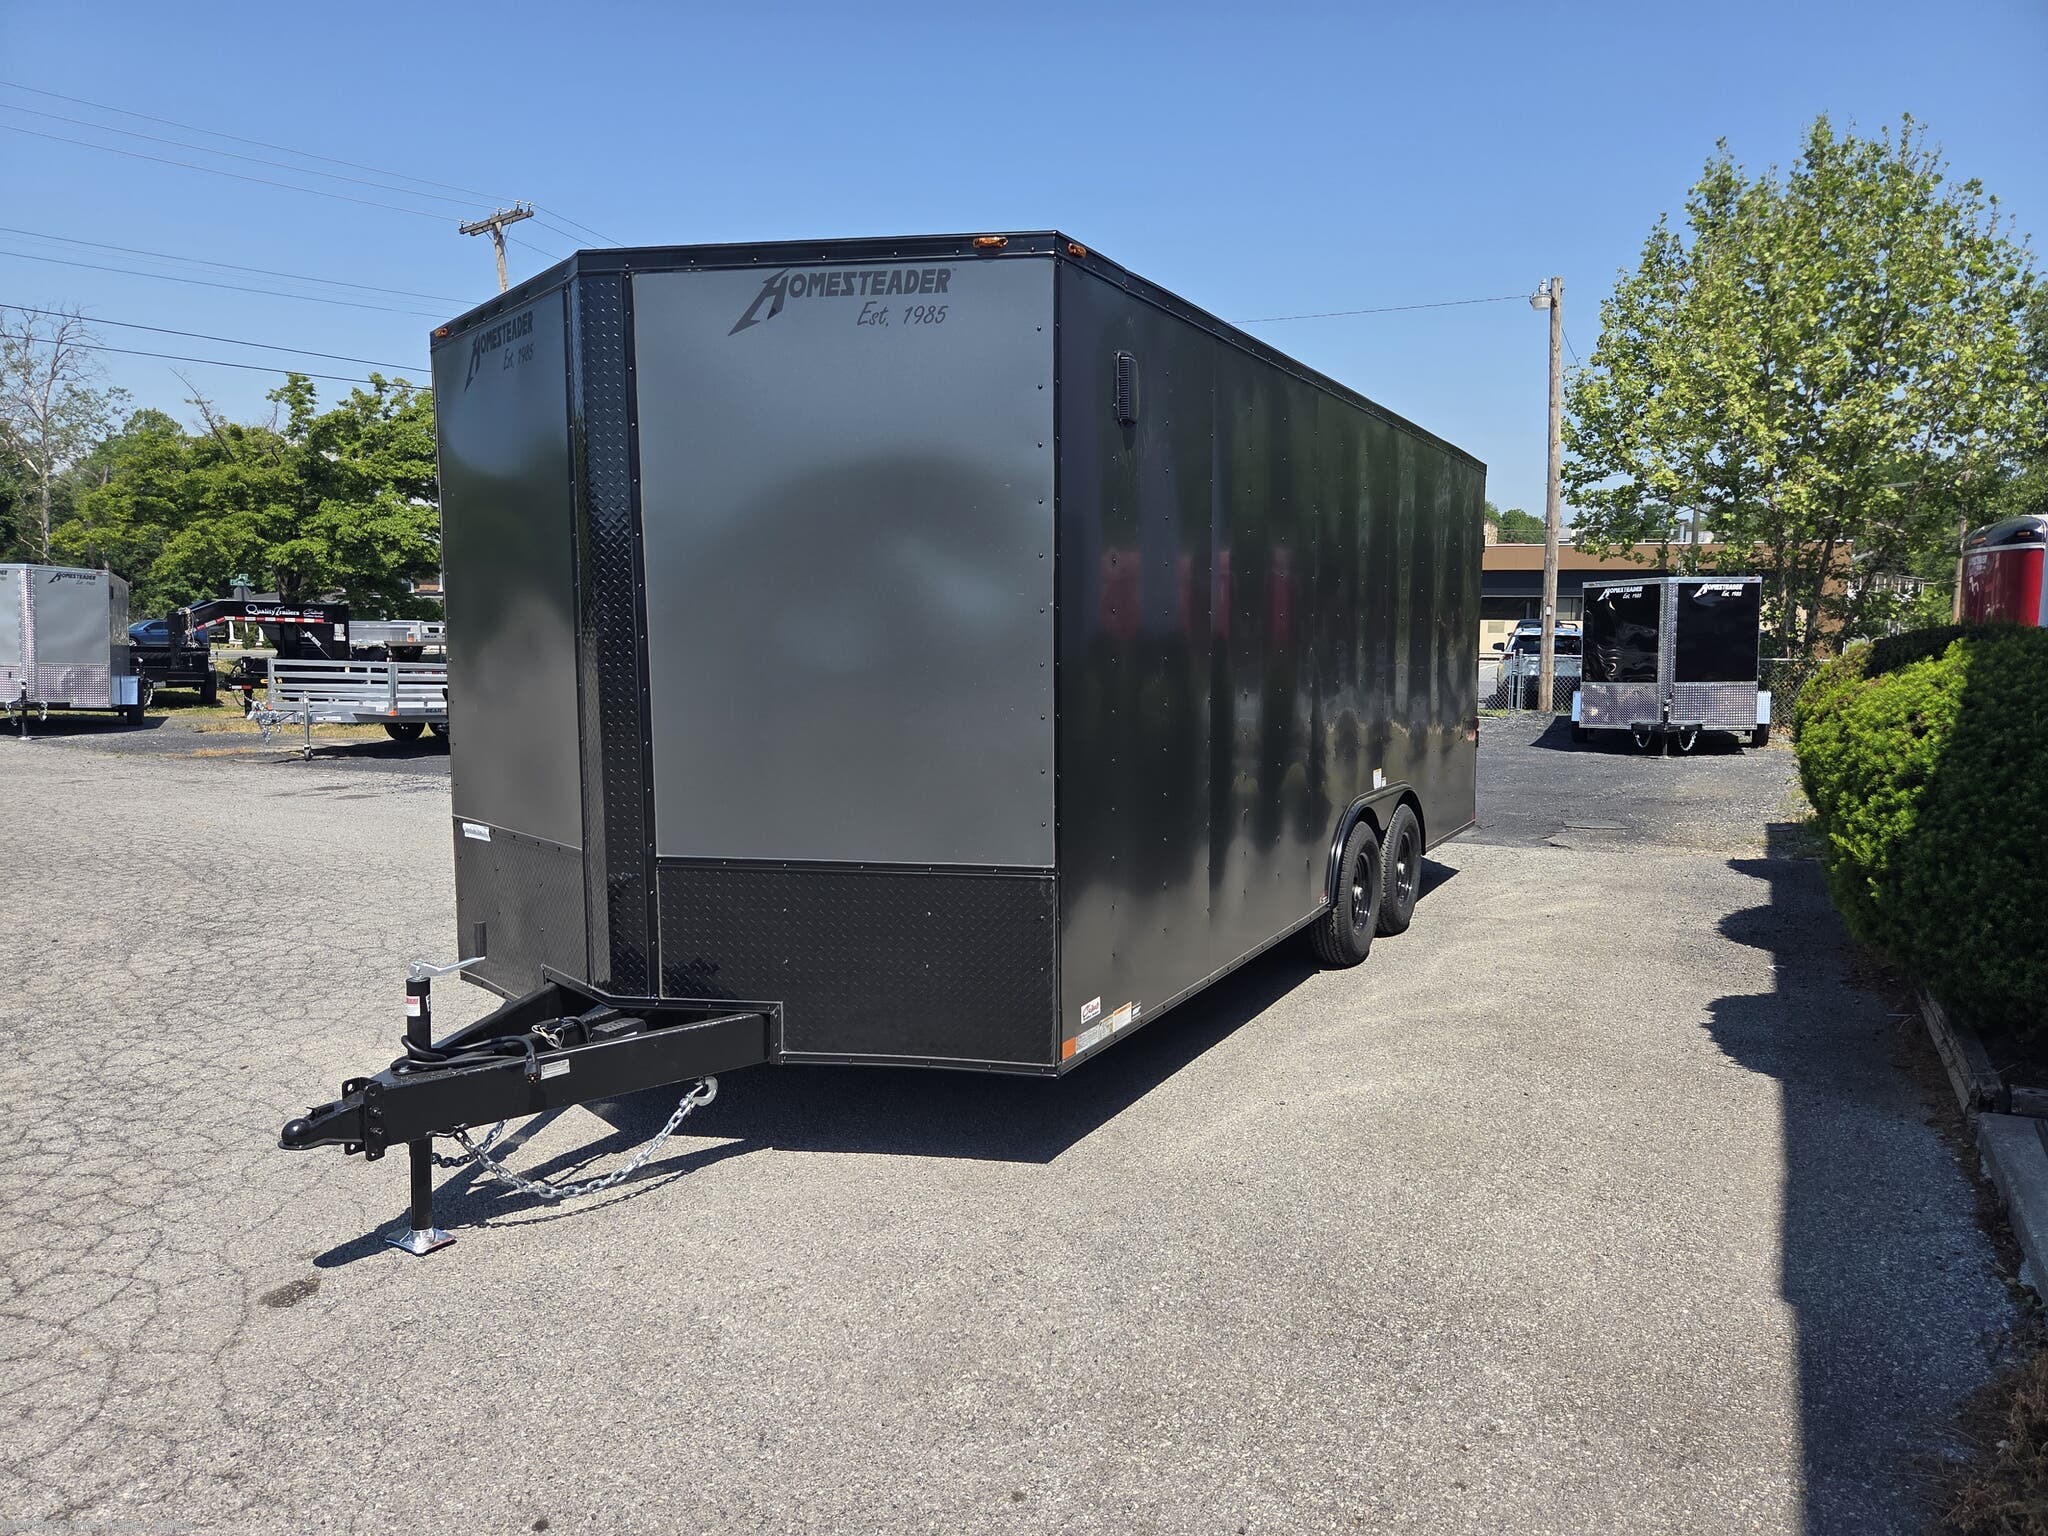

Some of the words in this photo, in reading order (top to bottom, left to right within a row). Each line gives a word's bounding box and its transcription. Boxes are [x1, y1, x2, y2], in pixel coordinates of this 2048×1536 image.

[728, 268, 952, 336] HOMESTEADER
[903, 305, 948, 325] 1985
[464, 310, 534, 392] HOMESTEADER
